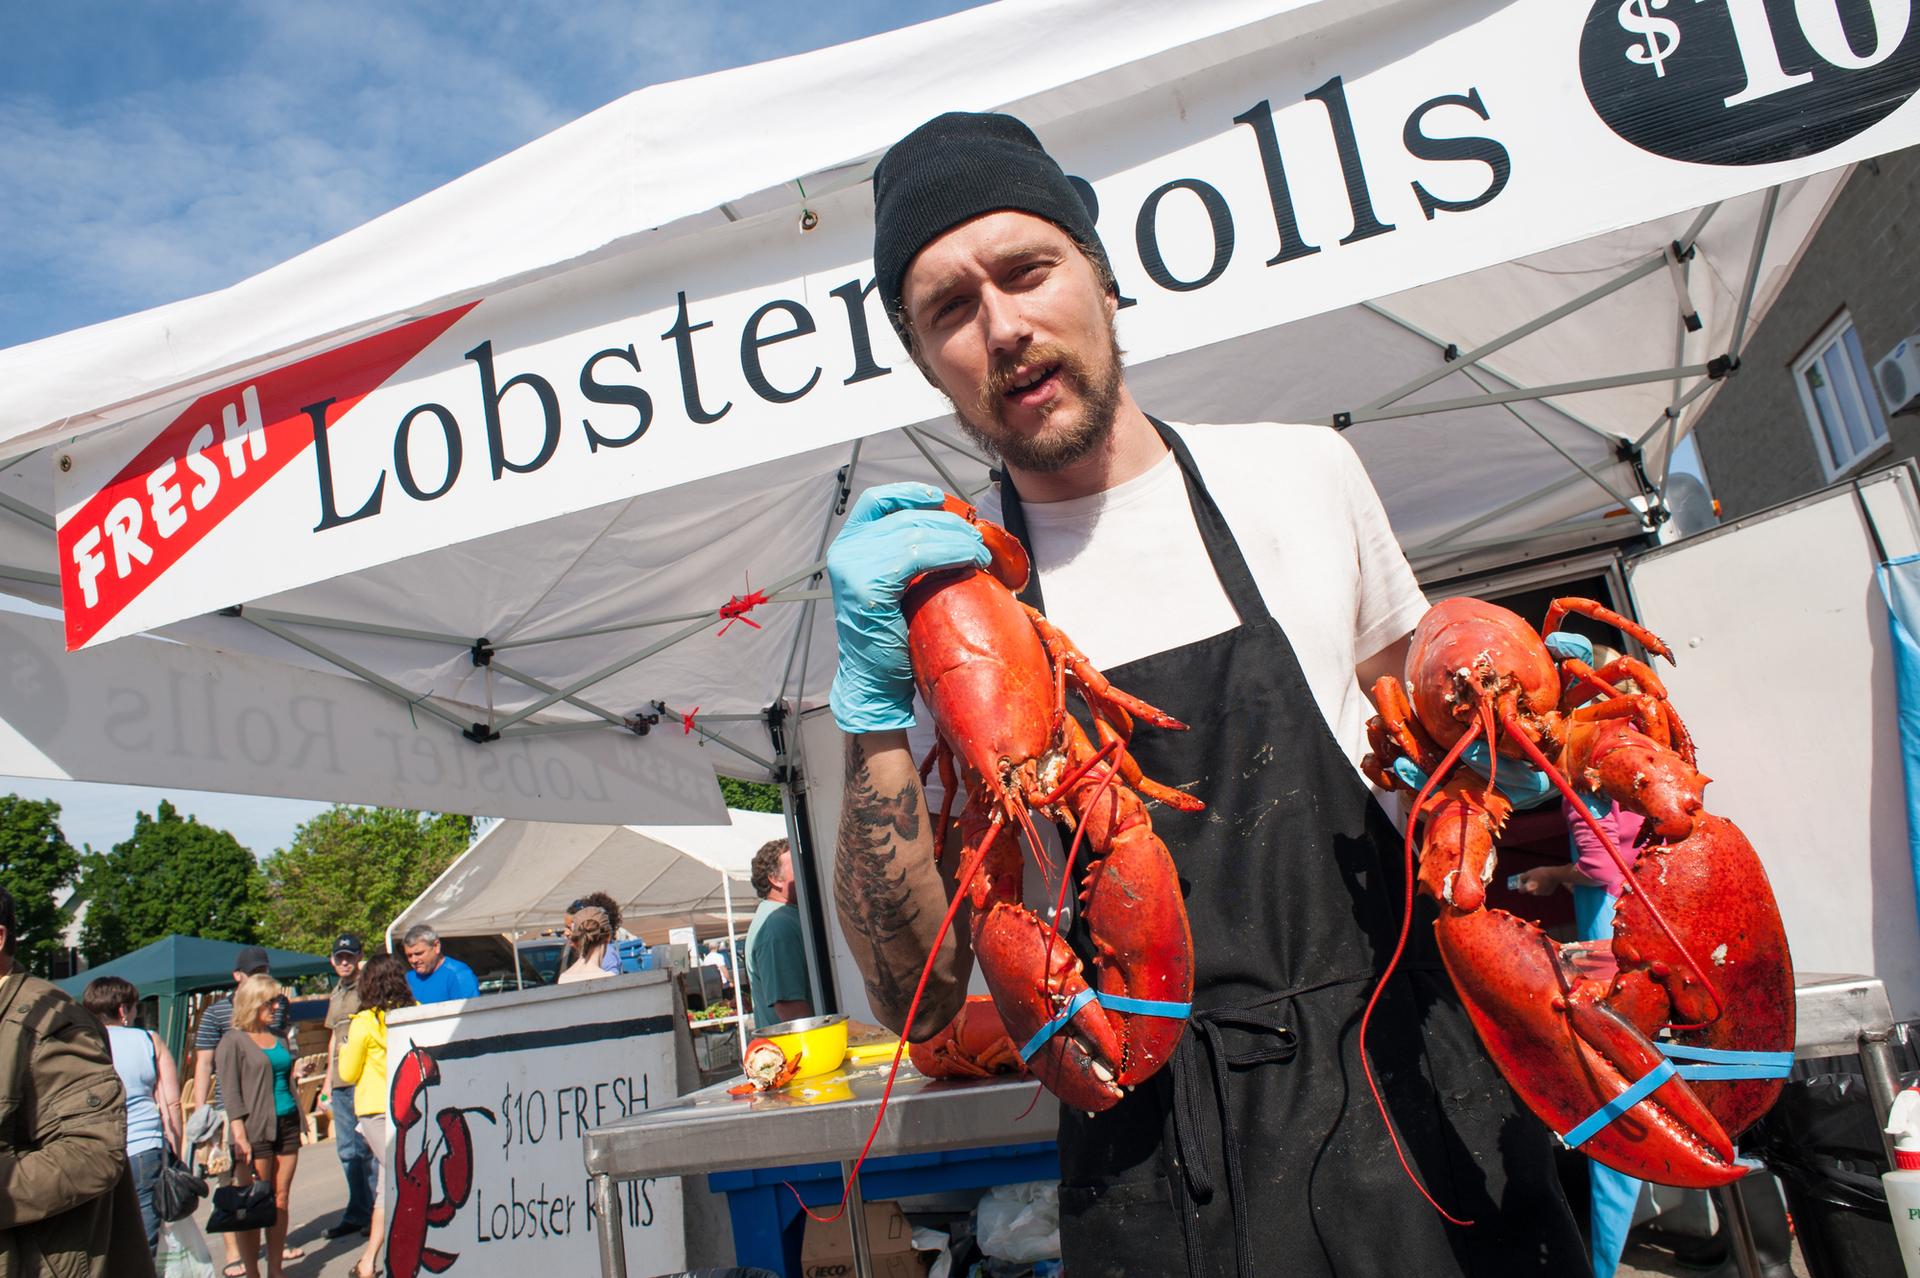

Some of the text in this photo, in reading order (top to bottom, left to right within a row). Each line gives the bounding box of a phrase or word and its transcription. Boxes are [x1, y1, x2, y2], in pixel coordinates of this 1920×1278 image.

[300, 75, 1511, 533] Lobster olls
[72, 384, 268, 608] FRESH
[502, 1073, 649, 1161] $10 FRESH
[477, 1177, 575, 1242] Lobster
